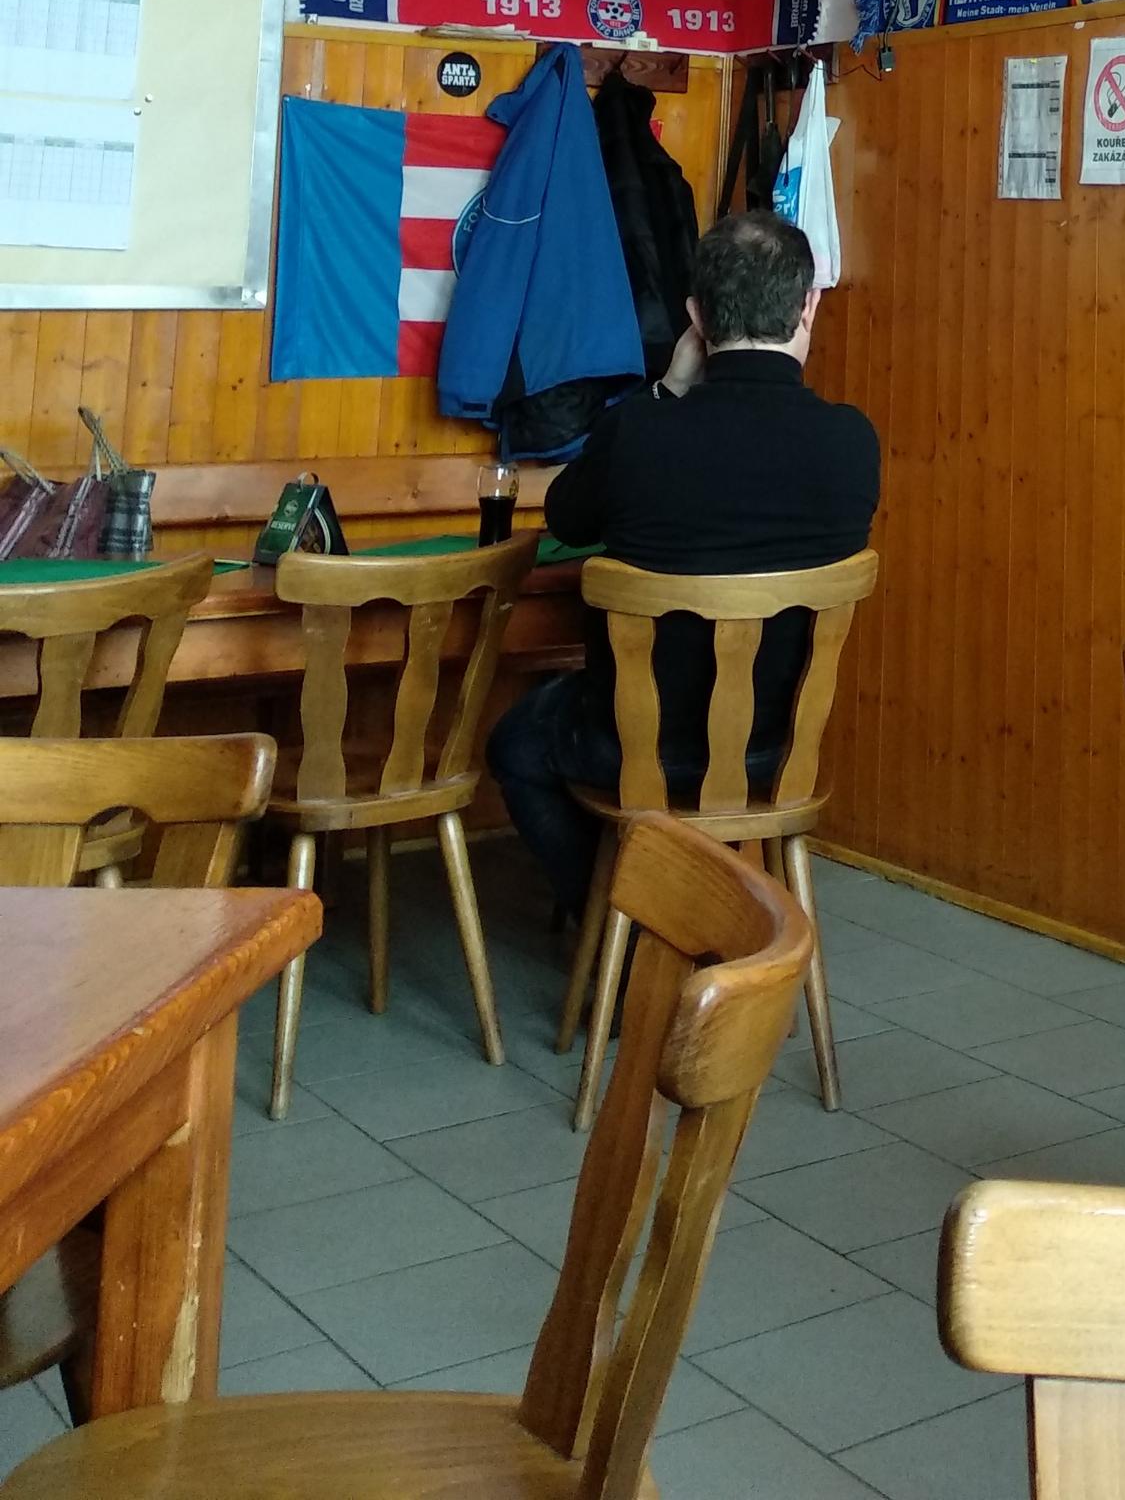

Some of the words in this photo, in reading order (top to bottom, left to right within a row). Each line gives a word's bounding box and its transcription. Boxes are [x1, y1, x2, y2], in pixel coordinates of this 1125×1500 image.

[1008, 4, 1029, 14] mein
[1030, 1, 1056, 12] Verein
[667, 7, 735, 33] 1913
[441, 75, 476, 86] SPARTA
